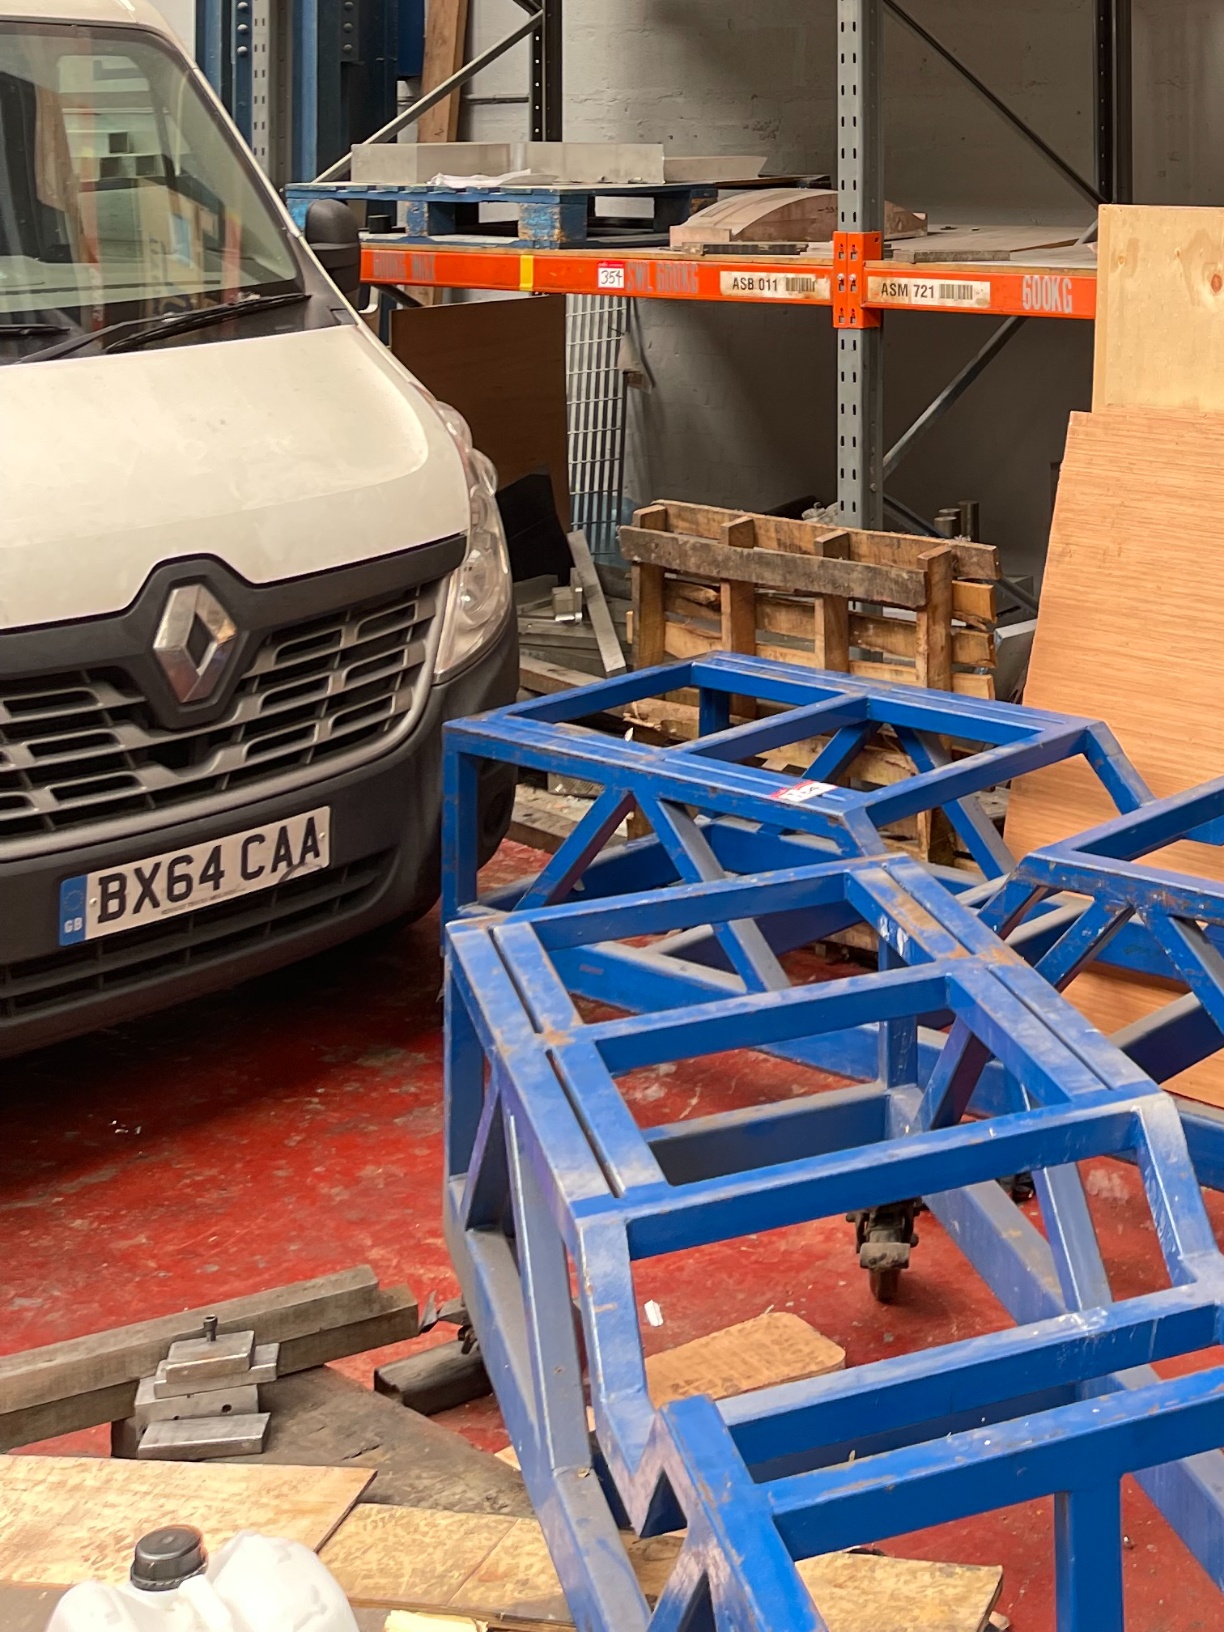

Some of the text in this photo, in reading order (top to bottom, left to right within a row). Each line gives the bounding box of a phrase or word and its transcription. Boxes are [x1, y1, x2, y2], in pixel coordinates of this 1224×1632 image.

[601, 270, 623, 286] 354
[732, 277, 778, 291] ASB 011
[881, 282, 934, 299] ASM 721
[1022, 275, 1073, 313] 600KG
[97, 816, 320, 924] BX64 CAA
[64, 917, 83, 933] GB
